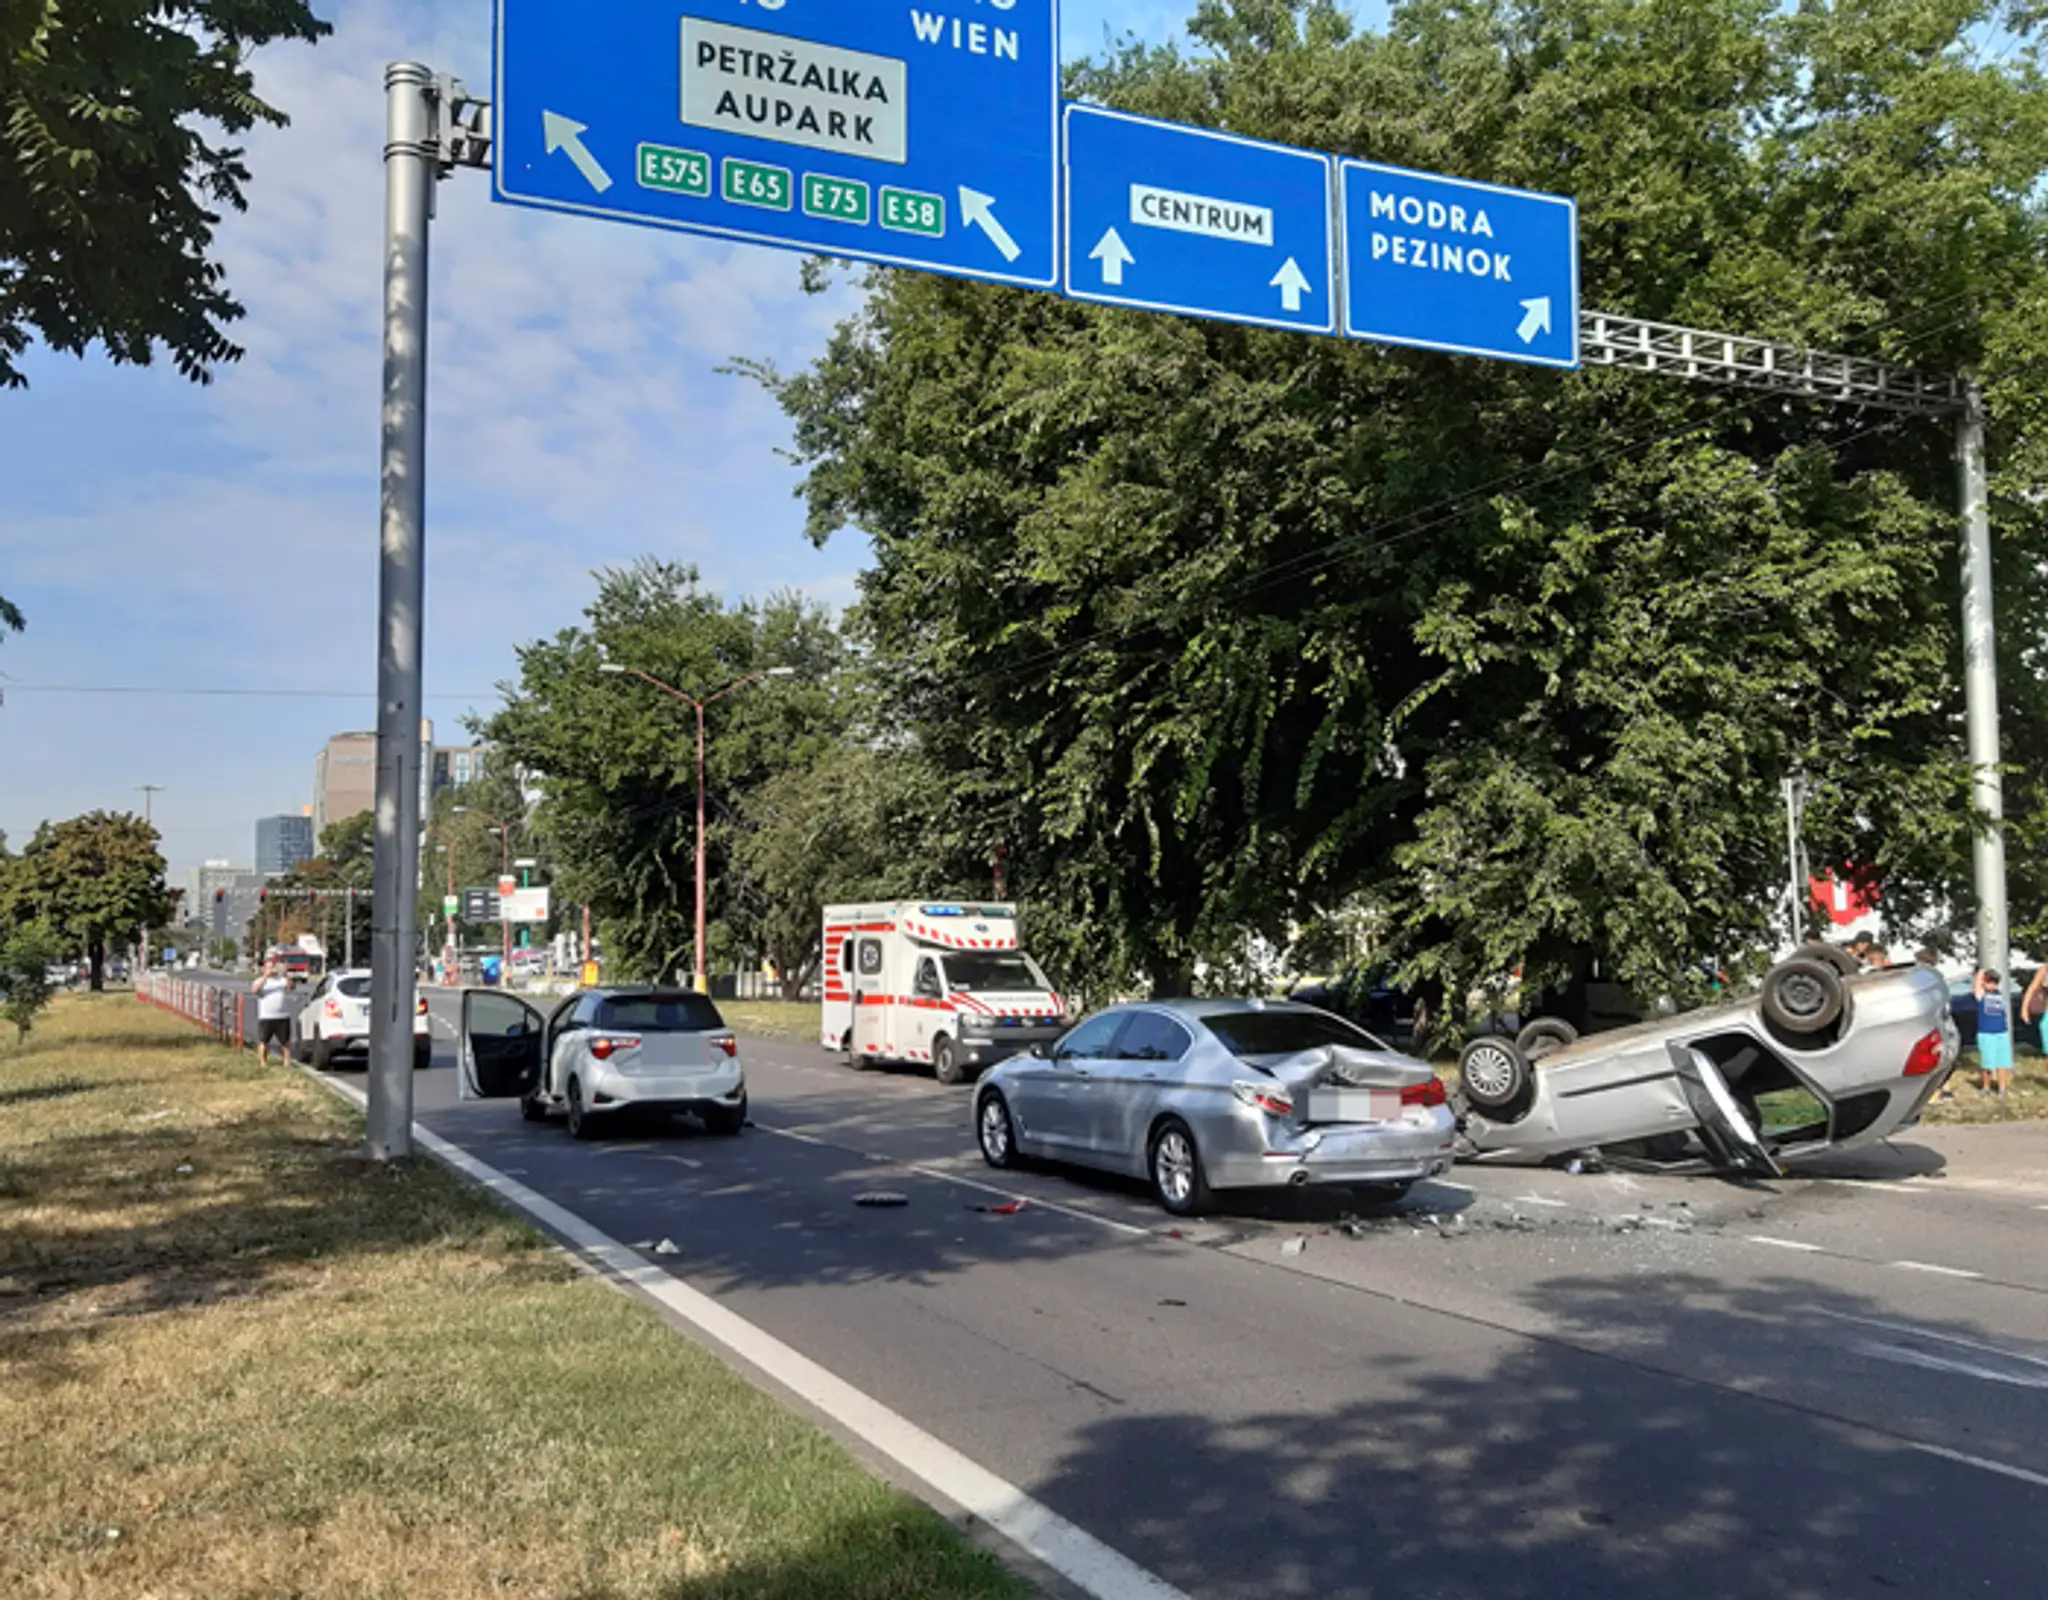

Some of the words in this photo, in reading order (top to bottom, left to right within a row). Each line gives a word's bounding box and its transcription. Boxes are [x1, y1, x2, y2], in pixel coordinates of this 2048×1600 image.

[911, 9, 1018, 60] WIEN
[697, 40, 888, 104] PETRŽALKA
[715, 90, 873, 143] AUPARK
[645, 153, 703, 186] E575
[733, 169, 781, 200] E65
[813, 183, 858, 213] E75
[887, 196, 935, 227] E58
[1141, 195, 1264, 235] CENTRUM
[1371, 192, 1493, 237] MODRA
[1373, 233, 1511, 281] PEZINOK
